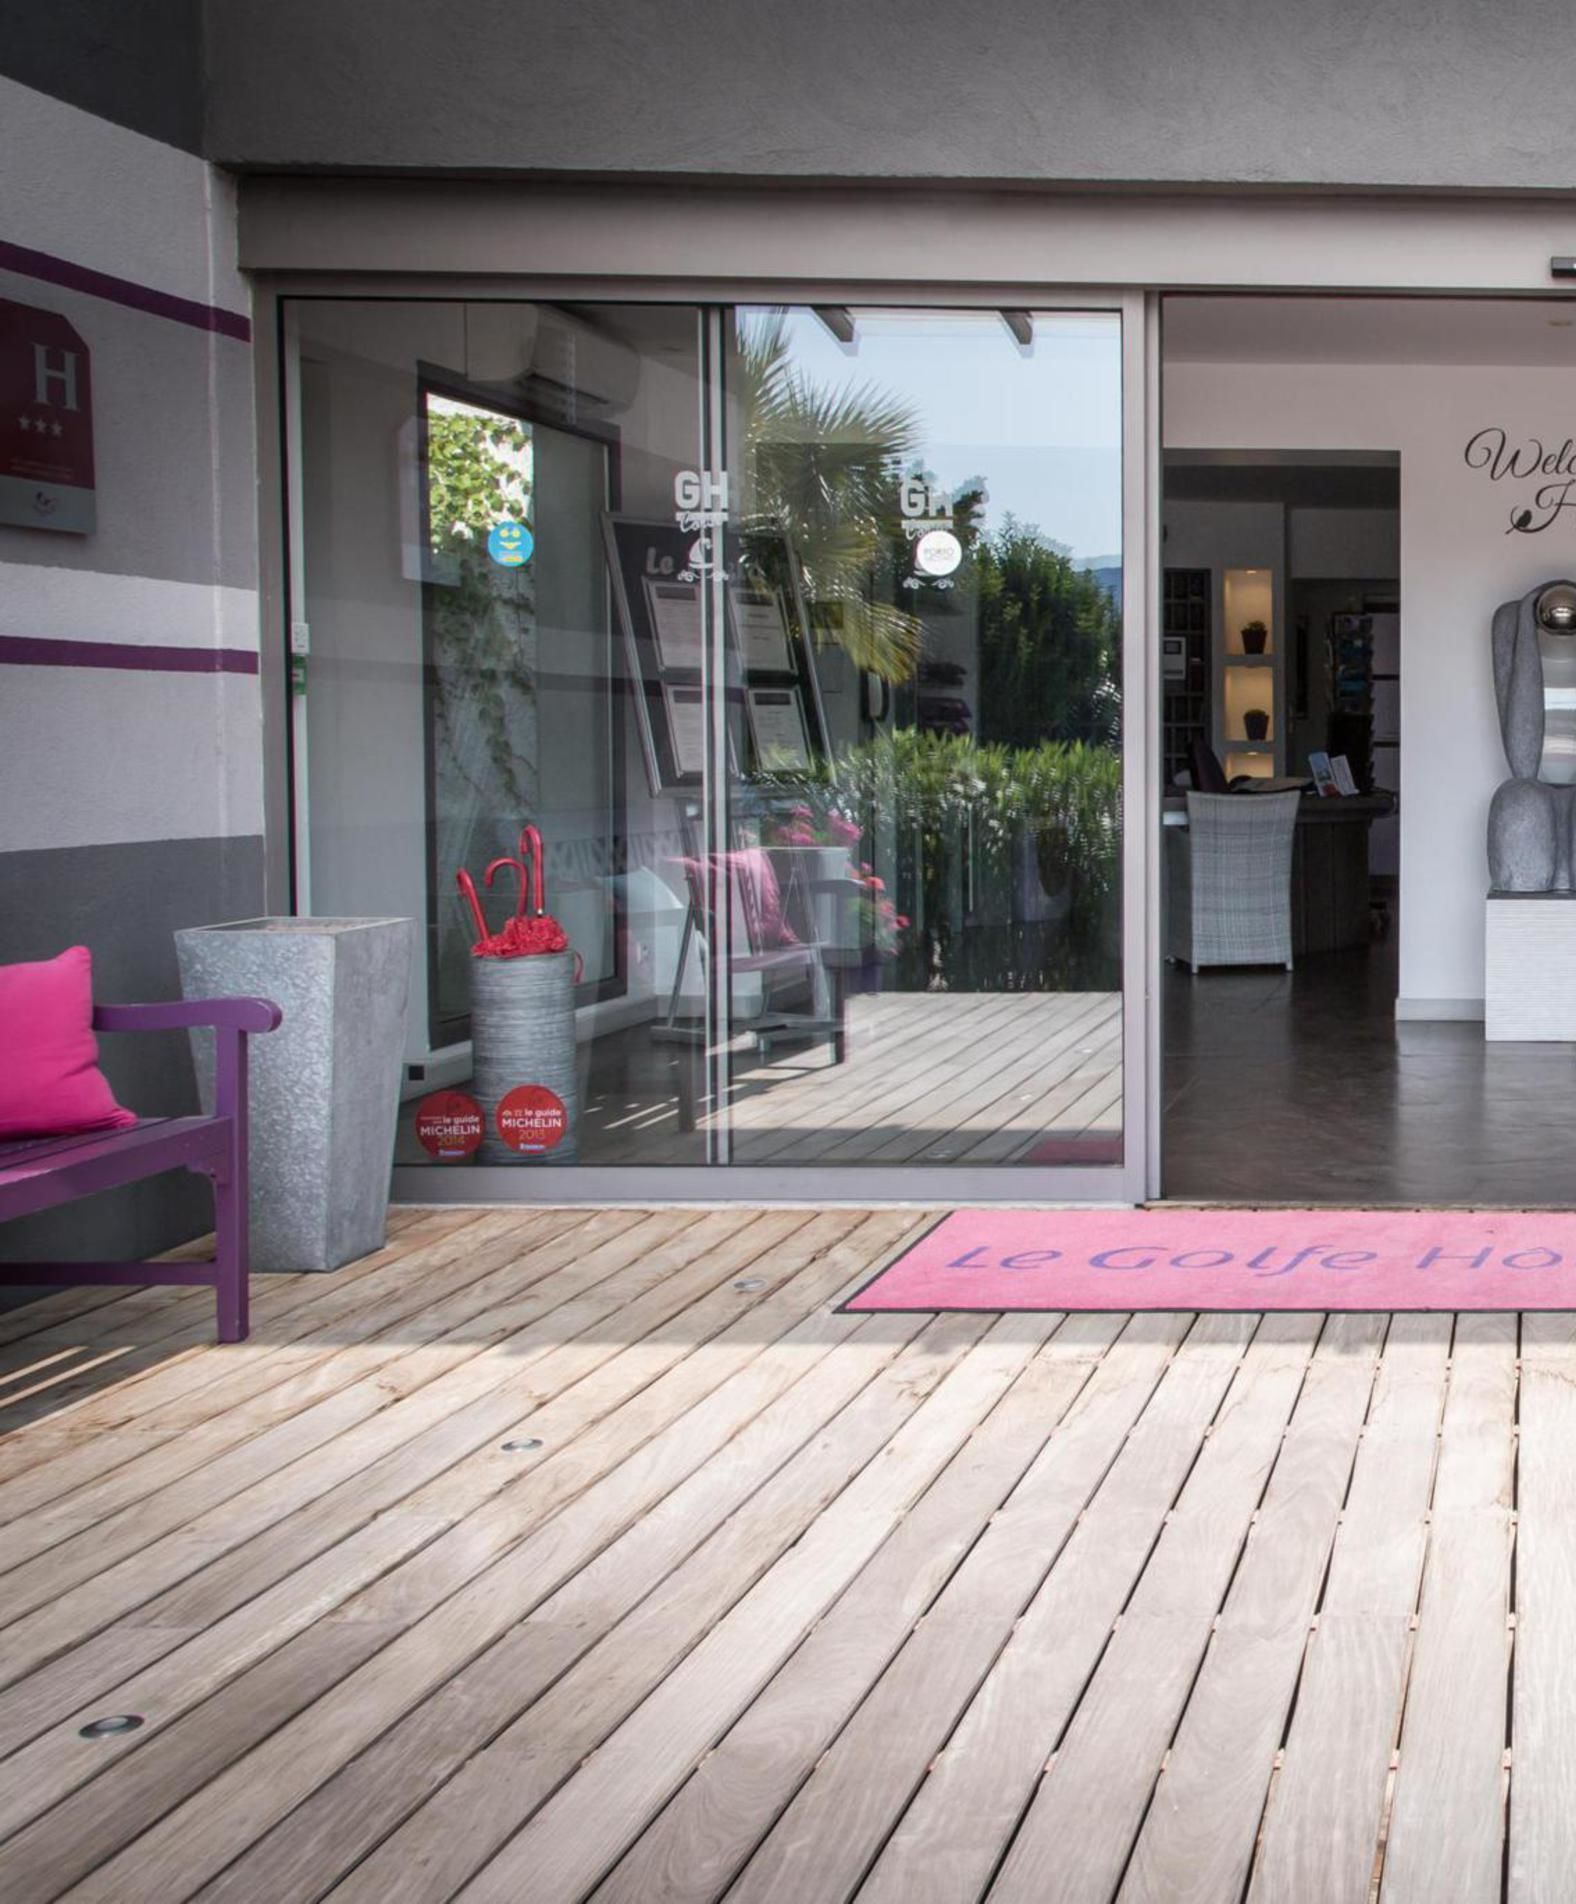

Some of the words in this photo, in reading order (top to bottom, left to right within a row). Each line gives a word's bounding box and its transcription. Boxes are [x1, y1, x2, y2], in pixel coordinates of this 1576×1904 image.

[33, 343, 80, 412] H
[674, 470, 728, 509] GH
[502, 1118, 562, 1129] MICHELIN
[535, 1109, 562, 1118] guide
[420, 1125, 481, 1137] MICHELIN
[946, 1246, 1063, 1270] Le
[1088, 1244, 1379, 1277] Golfe
